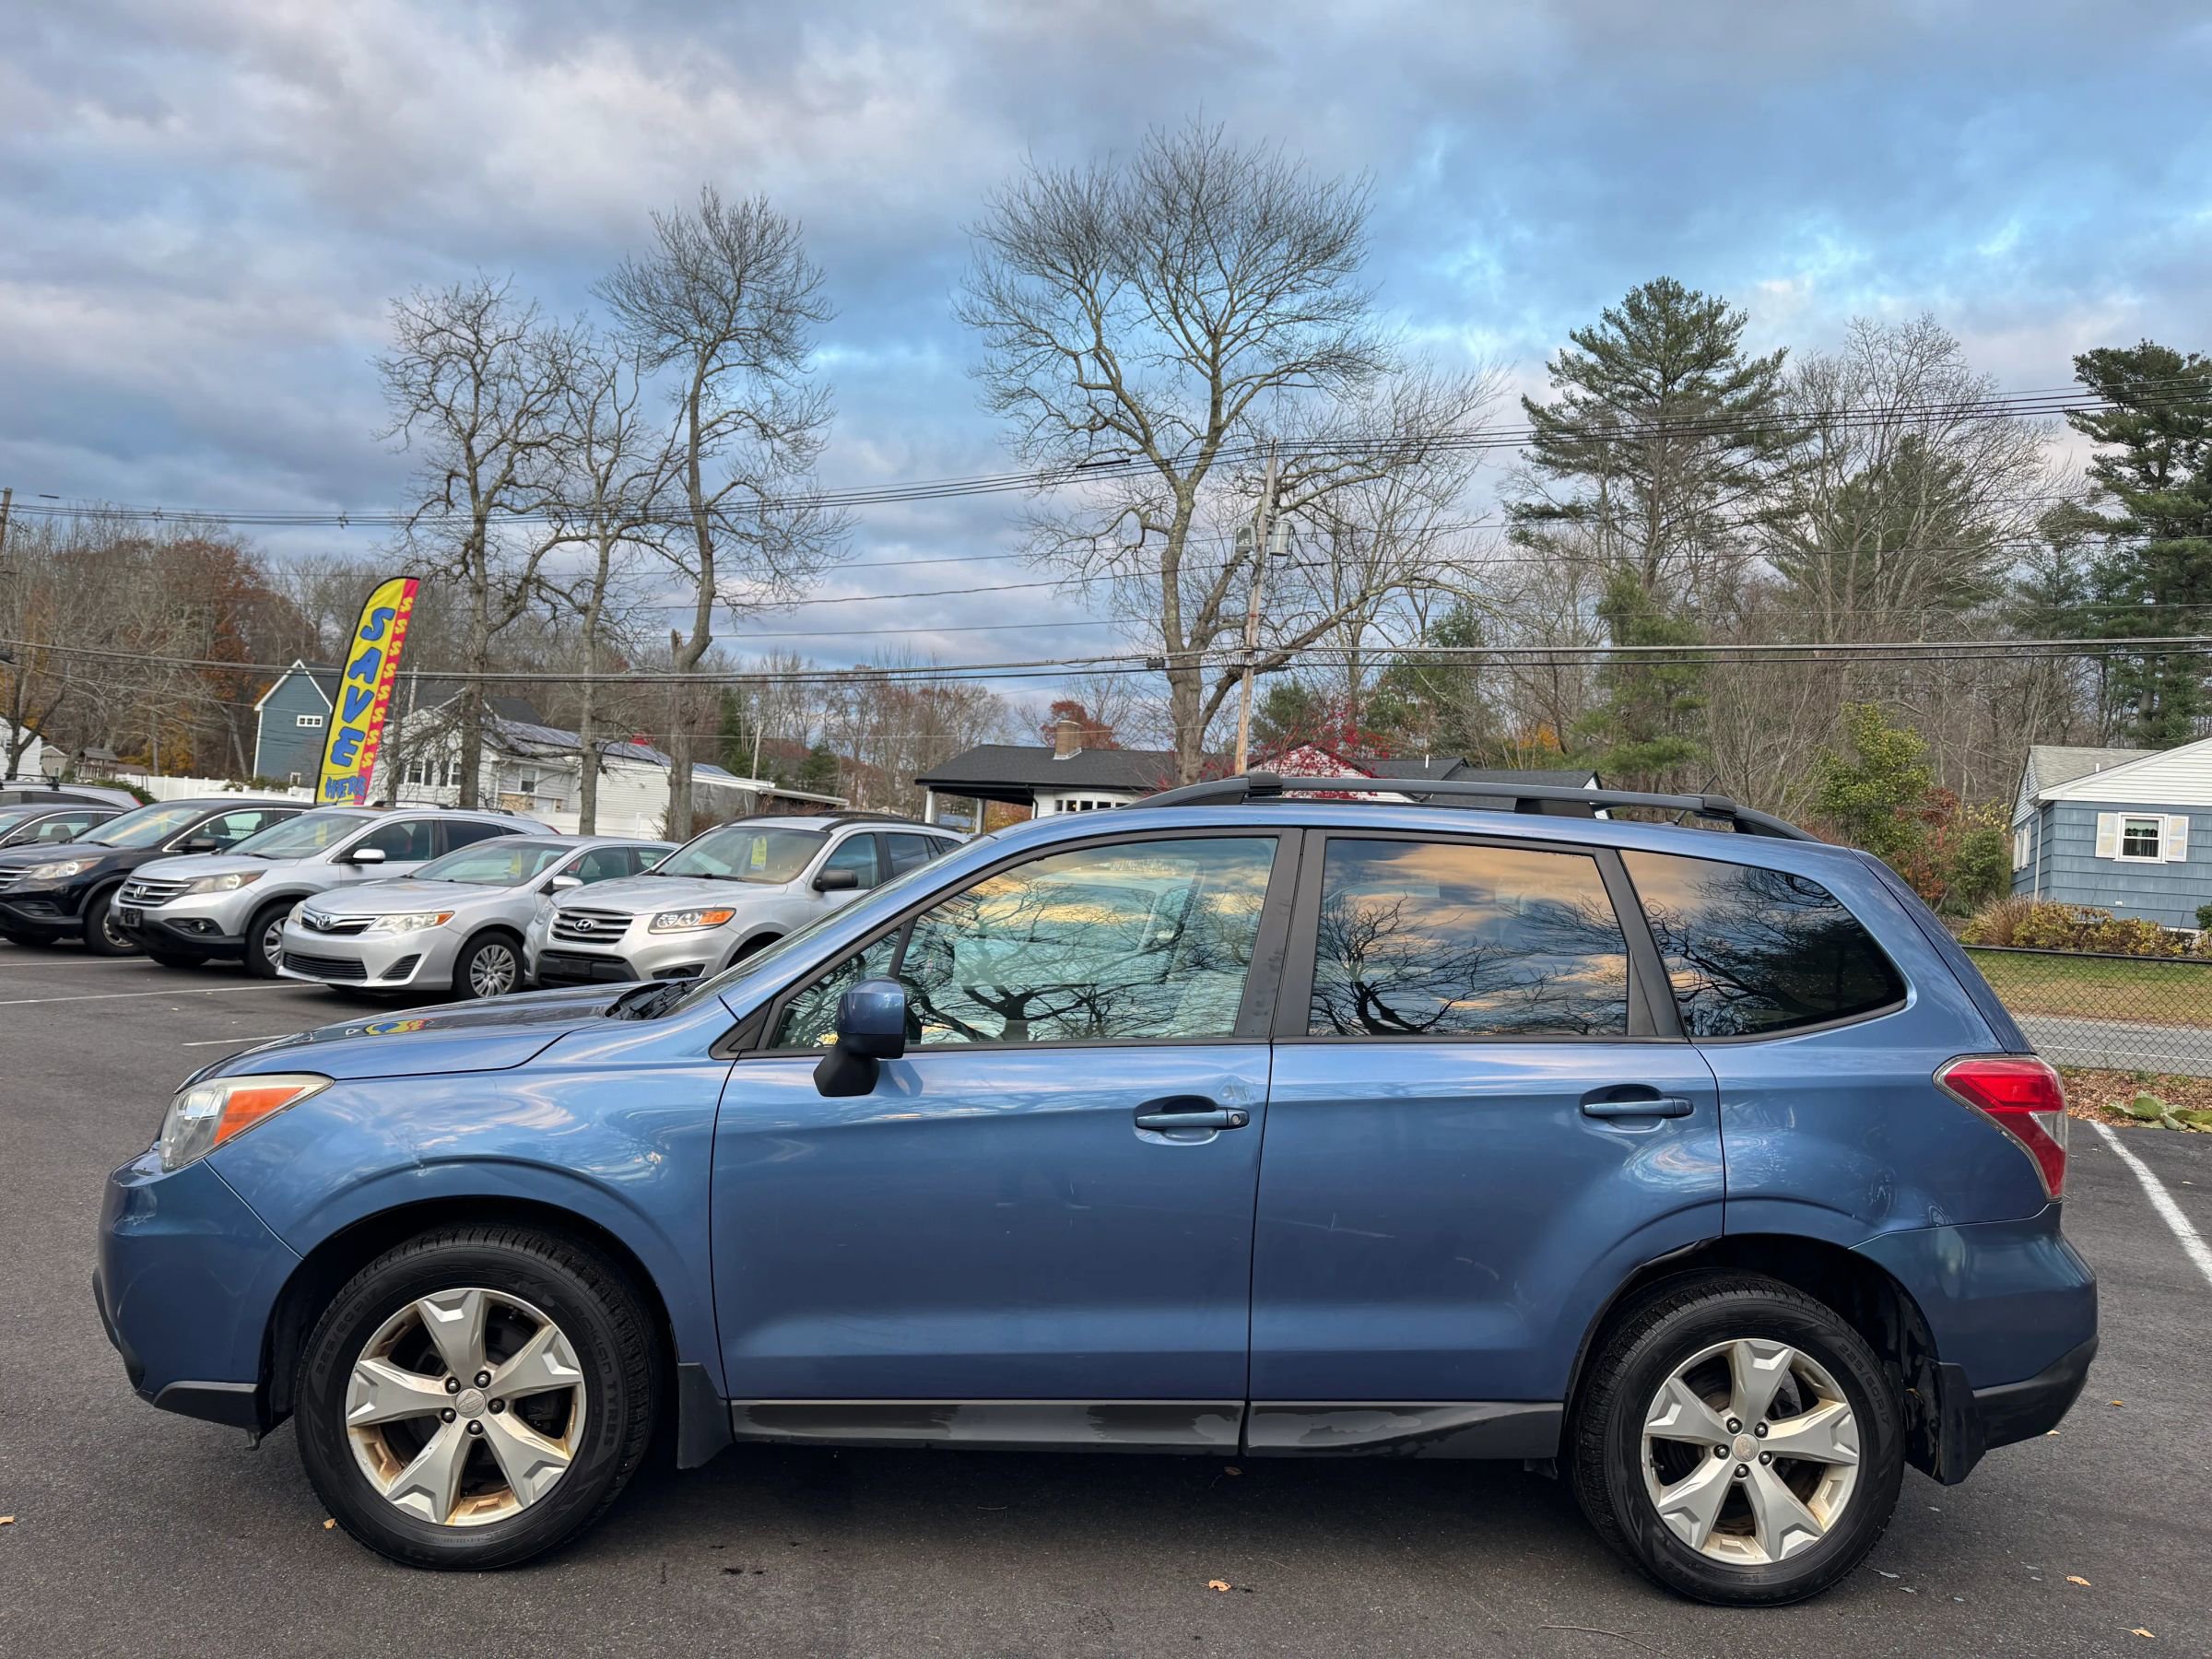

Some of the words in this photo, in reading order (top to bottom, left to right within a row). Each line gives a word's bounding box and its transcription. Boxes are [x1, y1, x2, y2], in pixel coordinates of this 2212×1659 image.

[330, 606, 396, 767] SAVE
[324, 775, 368, 799] HERE
[603, 1380, 618, 1446] TYRES
